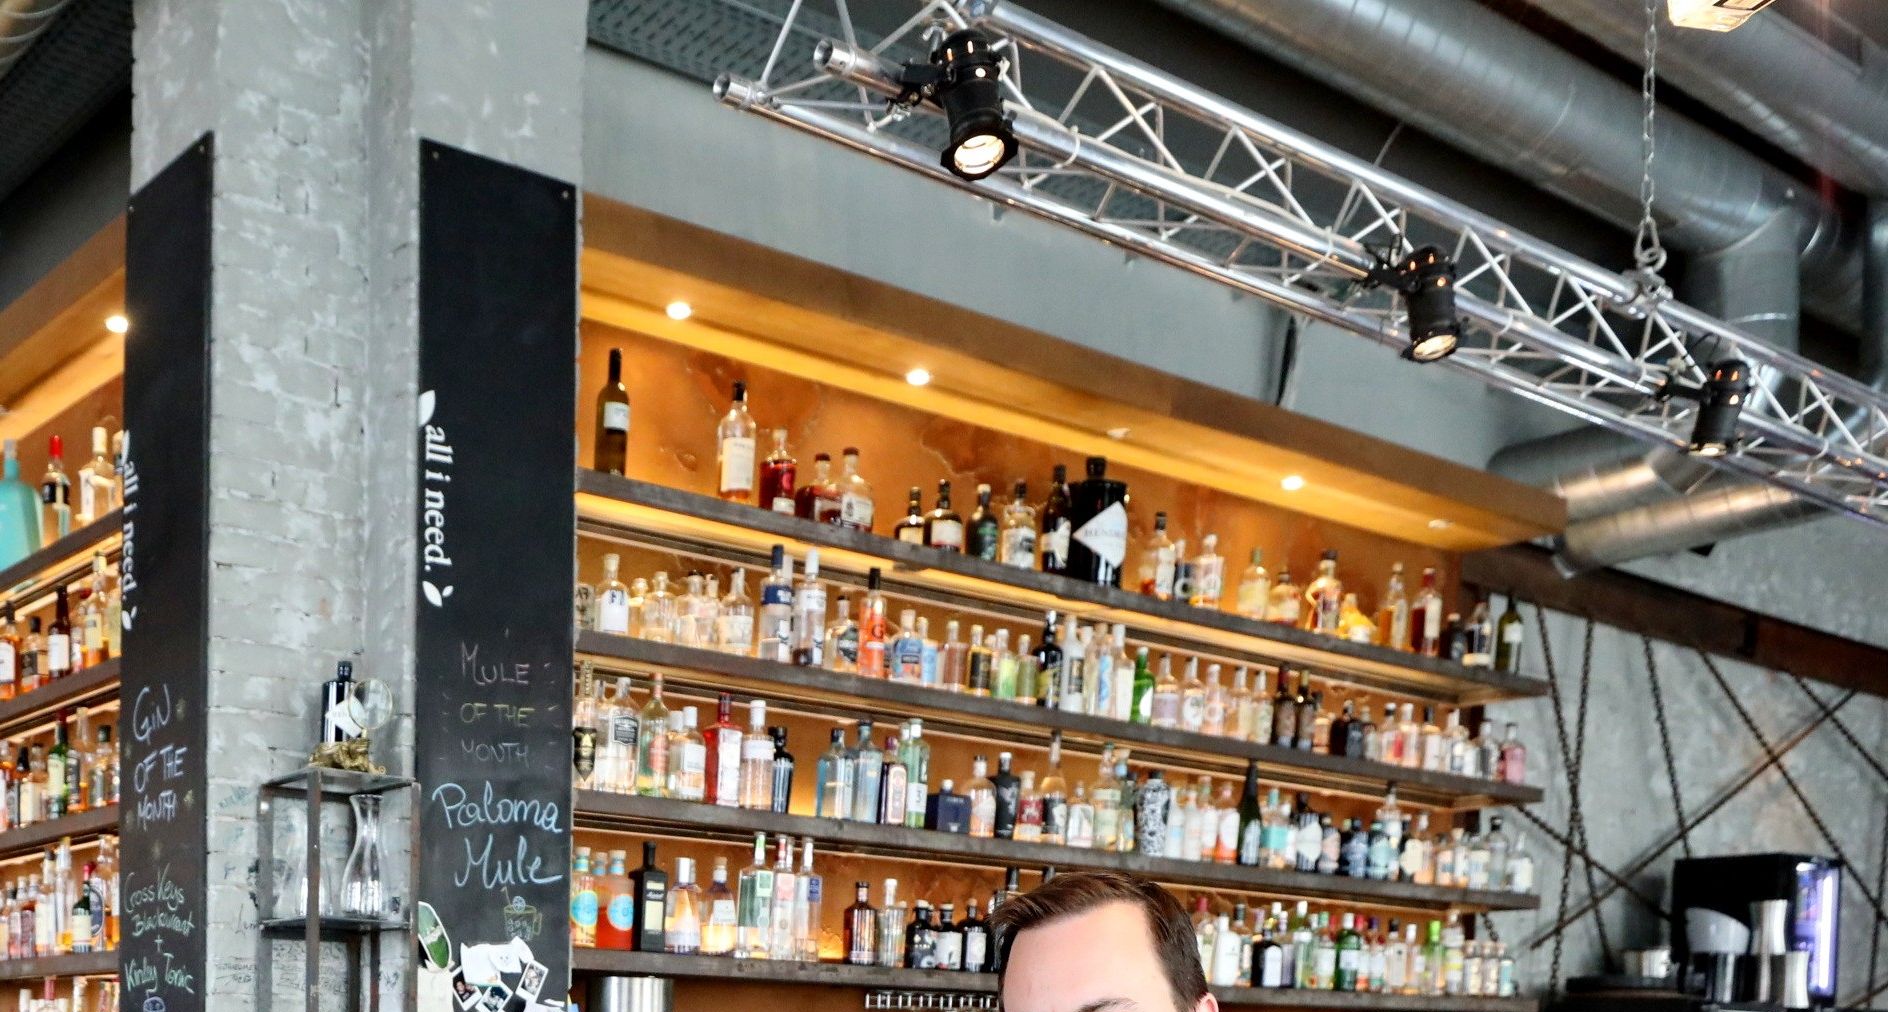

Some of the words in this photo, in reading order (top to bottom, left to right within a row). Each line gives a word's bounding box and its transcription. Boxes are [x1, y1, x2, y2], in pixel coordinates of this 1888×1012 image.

[425, 424, 453, 464] all
[425, 469, 451, 482] i
[424, 488, 452, 572] need.
[461, 702, 487, 723] OF
[493, 703, 535, 727] THE
[134, 751, 159, 793] OF
[432, 780, 563, 833] Paloma
[454, 833, 563, 889] Mule
